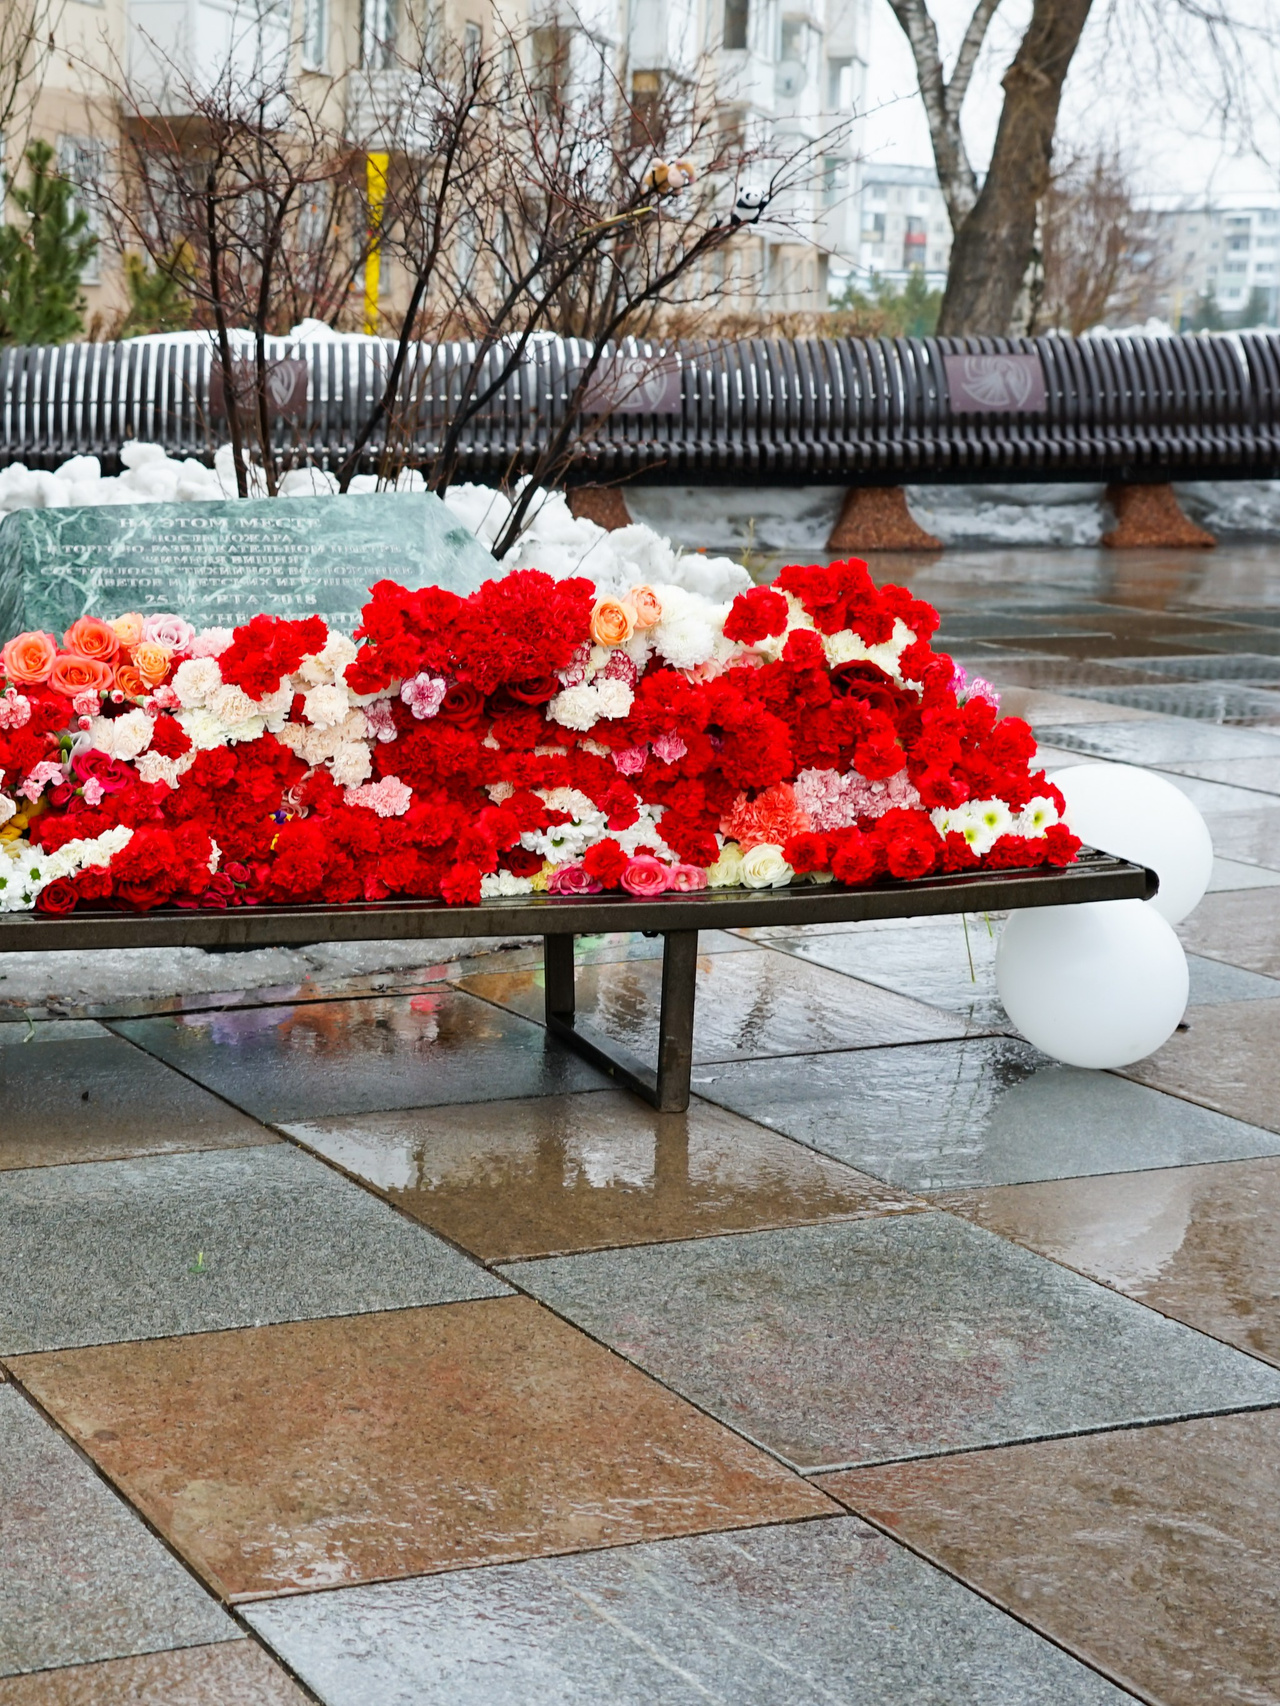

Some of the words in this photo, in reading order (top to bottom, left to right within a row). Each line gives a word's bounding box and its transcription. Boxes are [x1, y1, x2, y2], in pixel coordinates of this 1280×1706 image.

[120, 517, 151, 529] НА
[159, 517, 228, 529] ЭТОМ
[240, 517, 321, 528] МЕСТЕ
[152, 534, 214, 543] ПОСЛЕ
[219, 533, 293, 543] ПОЖАРА
[169, 578, 180, 587] И
[145, 595, 169, 604] 25
[177, 594, 259, 604] МАРТА
[268, 594, 317, 605] 2018
